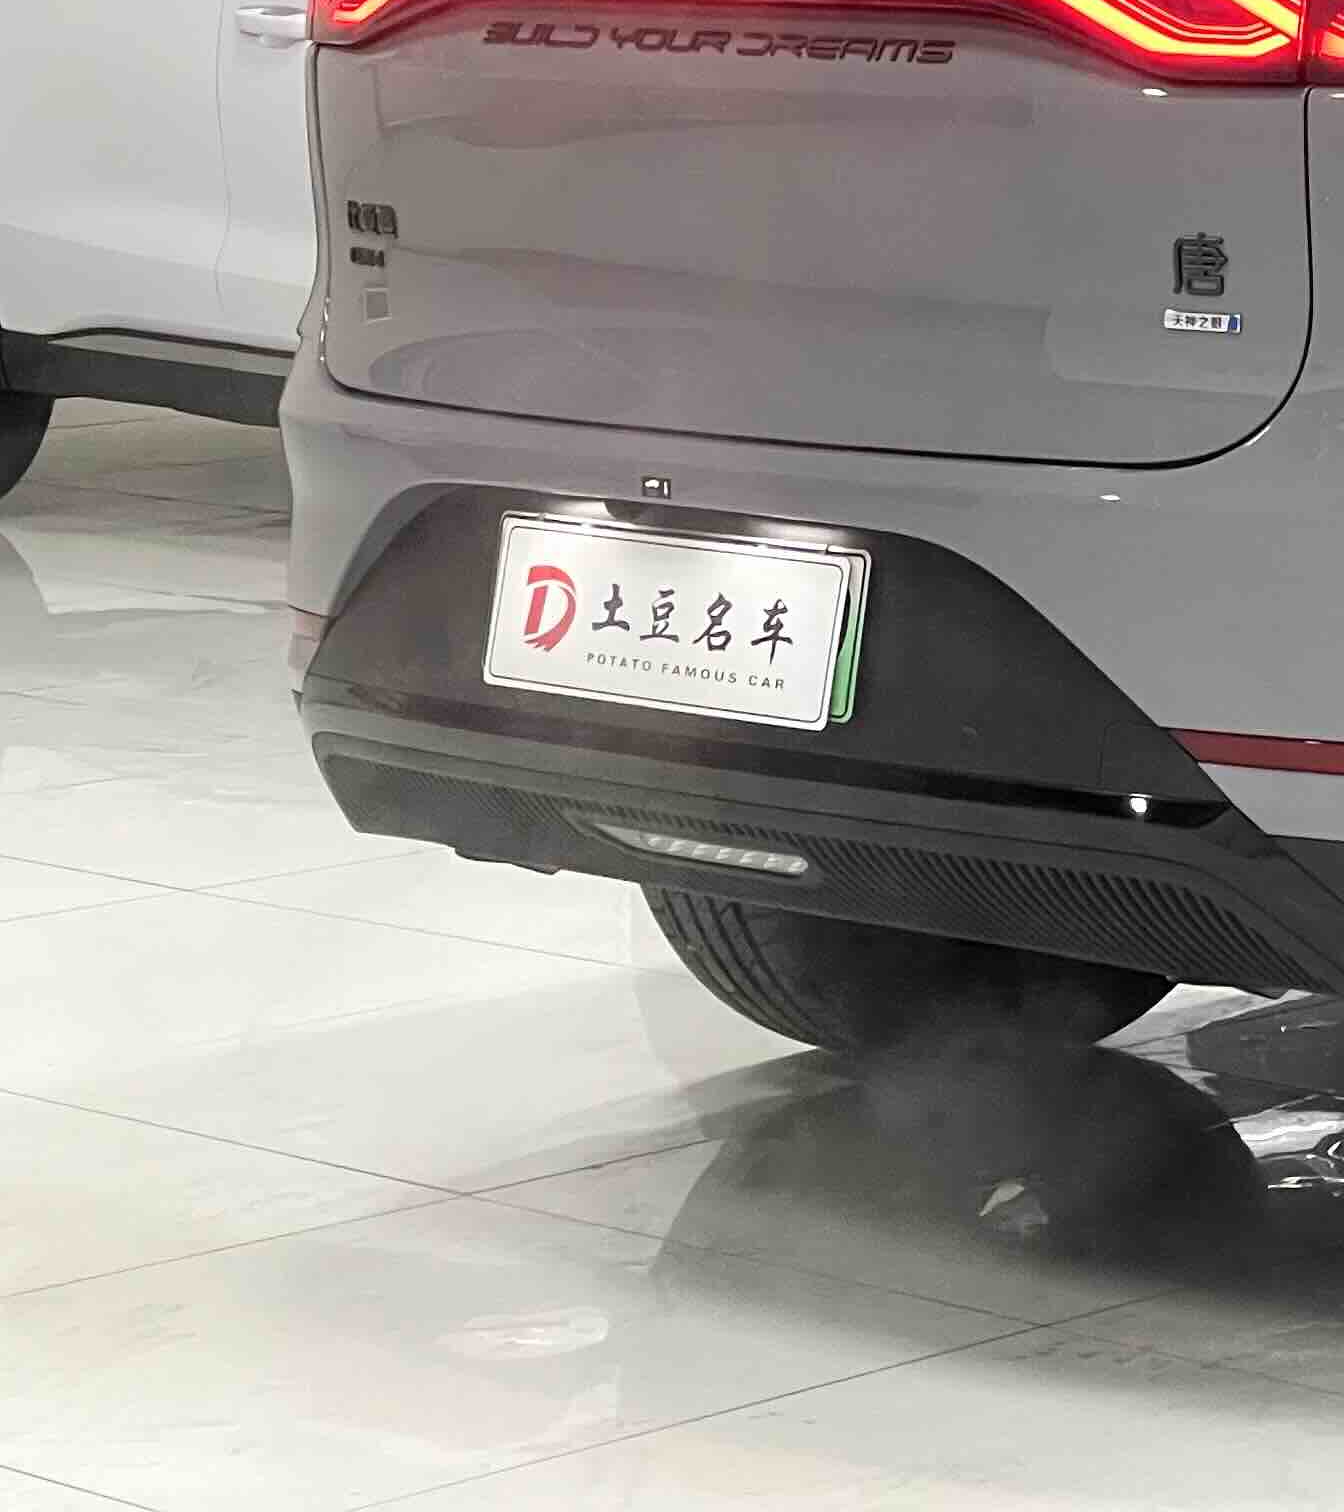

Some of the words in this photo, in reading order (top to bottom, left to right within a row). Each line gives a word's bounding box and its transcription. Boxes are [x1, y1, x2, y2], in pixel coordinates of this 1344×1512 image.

[481, 20, 598, 50] BUILD
[610, 26, 732, 55] YOUR
[736, 32, 956, 65] DREAMS
[591, 583, 794, 665] 土豆名车
[586, 652, 652, 673] POTATO
[661, 664, 738, 685] FAMOUS
[748, 674, 785, 690] CAR
